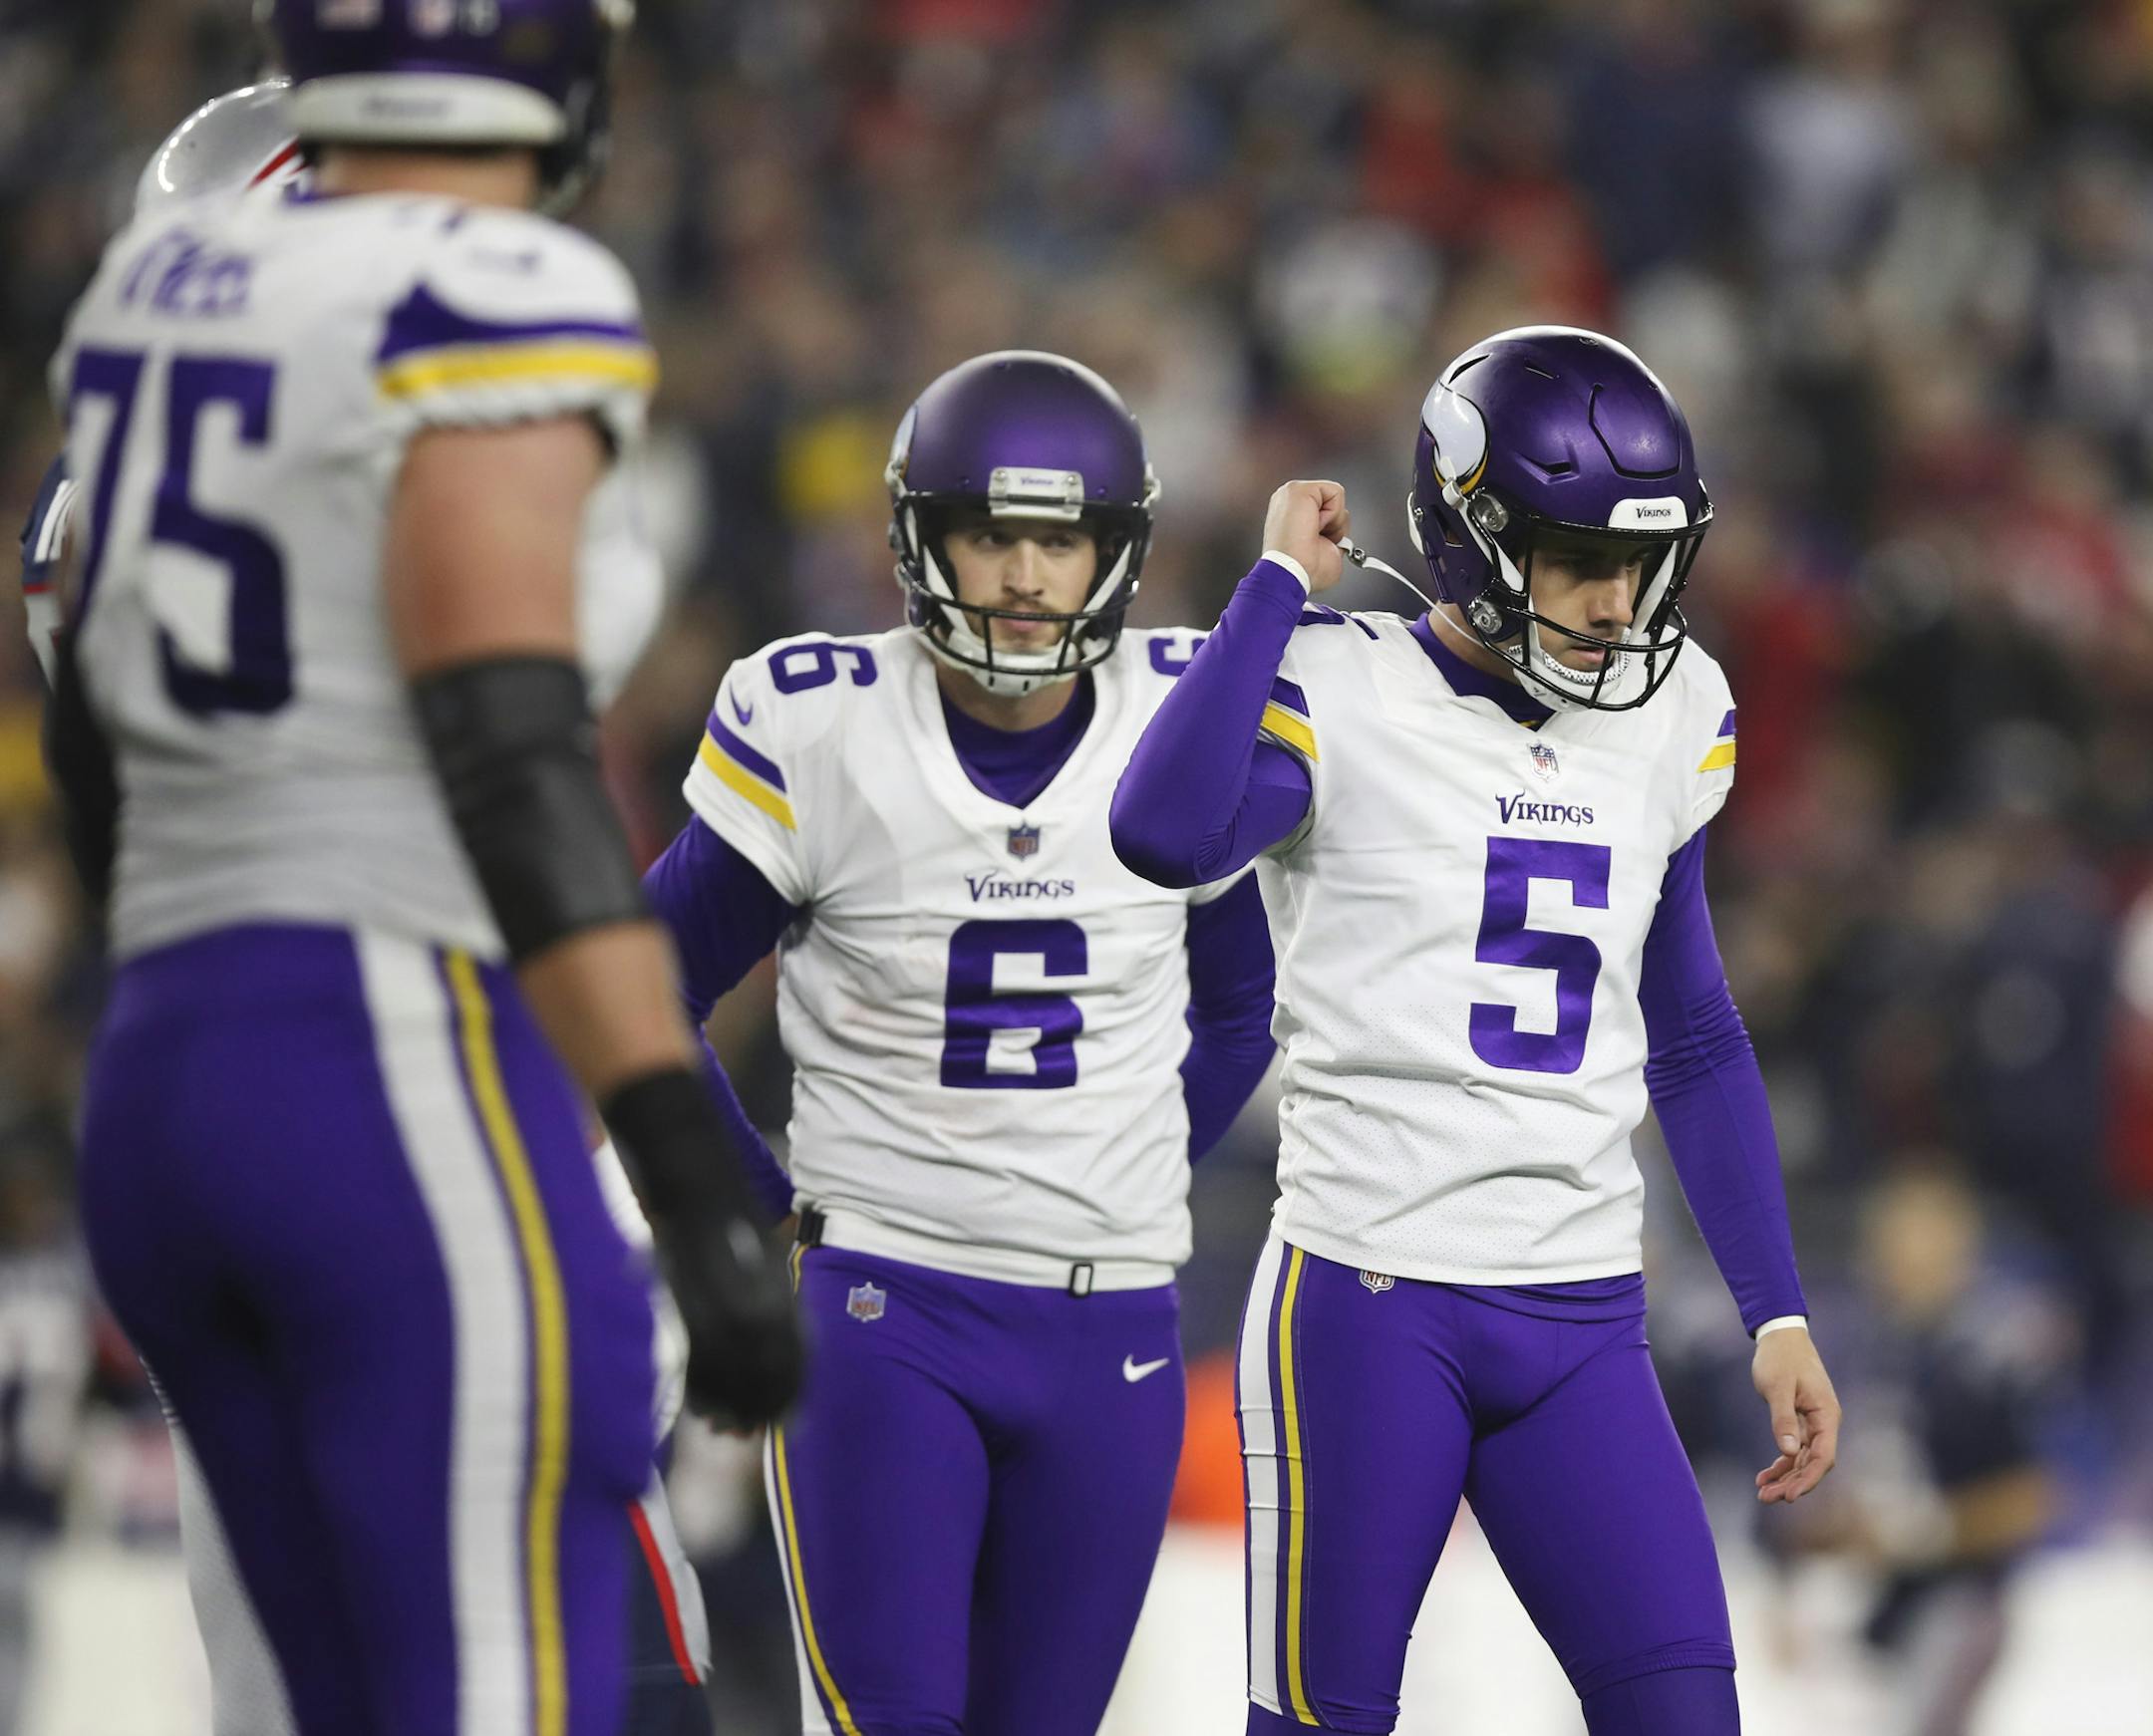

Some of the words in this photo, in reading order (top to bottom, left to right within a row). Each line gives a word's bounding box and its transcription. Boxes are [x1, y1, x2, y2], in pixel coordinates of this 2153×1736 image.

[68, 347, 292, 715] 75
[1636, 505, 1672, 518] VIKINGS
[1495, 788, 1594, 827] VIKINGS
[964, 869, 1076, 903] VIKINGS
[940, 919, 1088, 1089] 6
[1468, 835, 1611, 1074] 5
